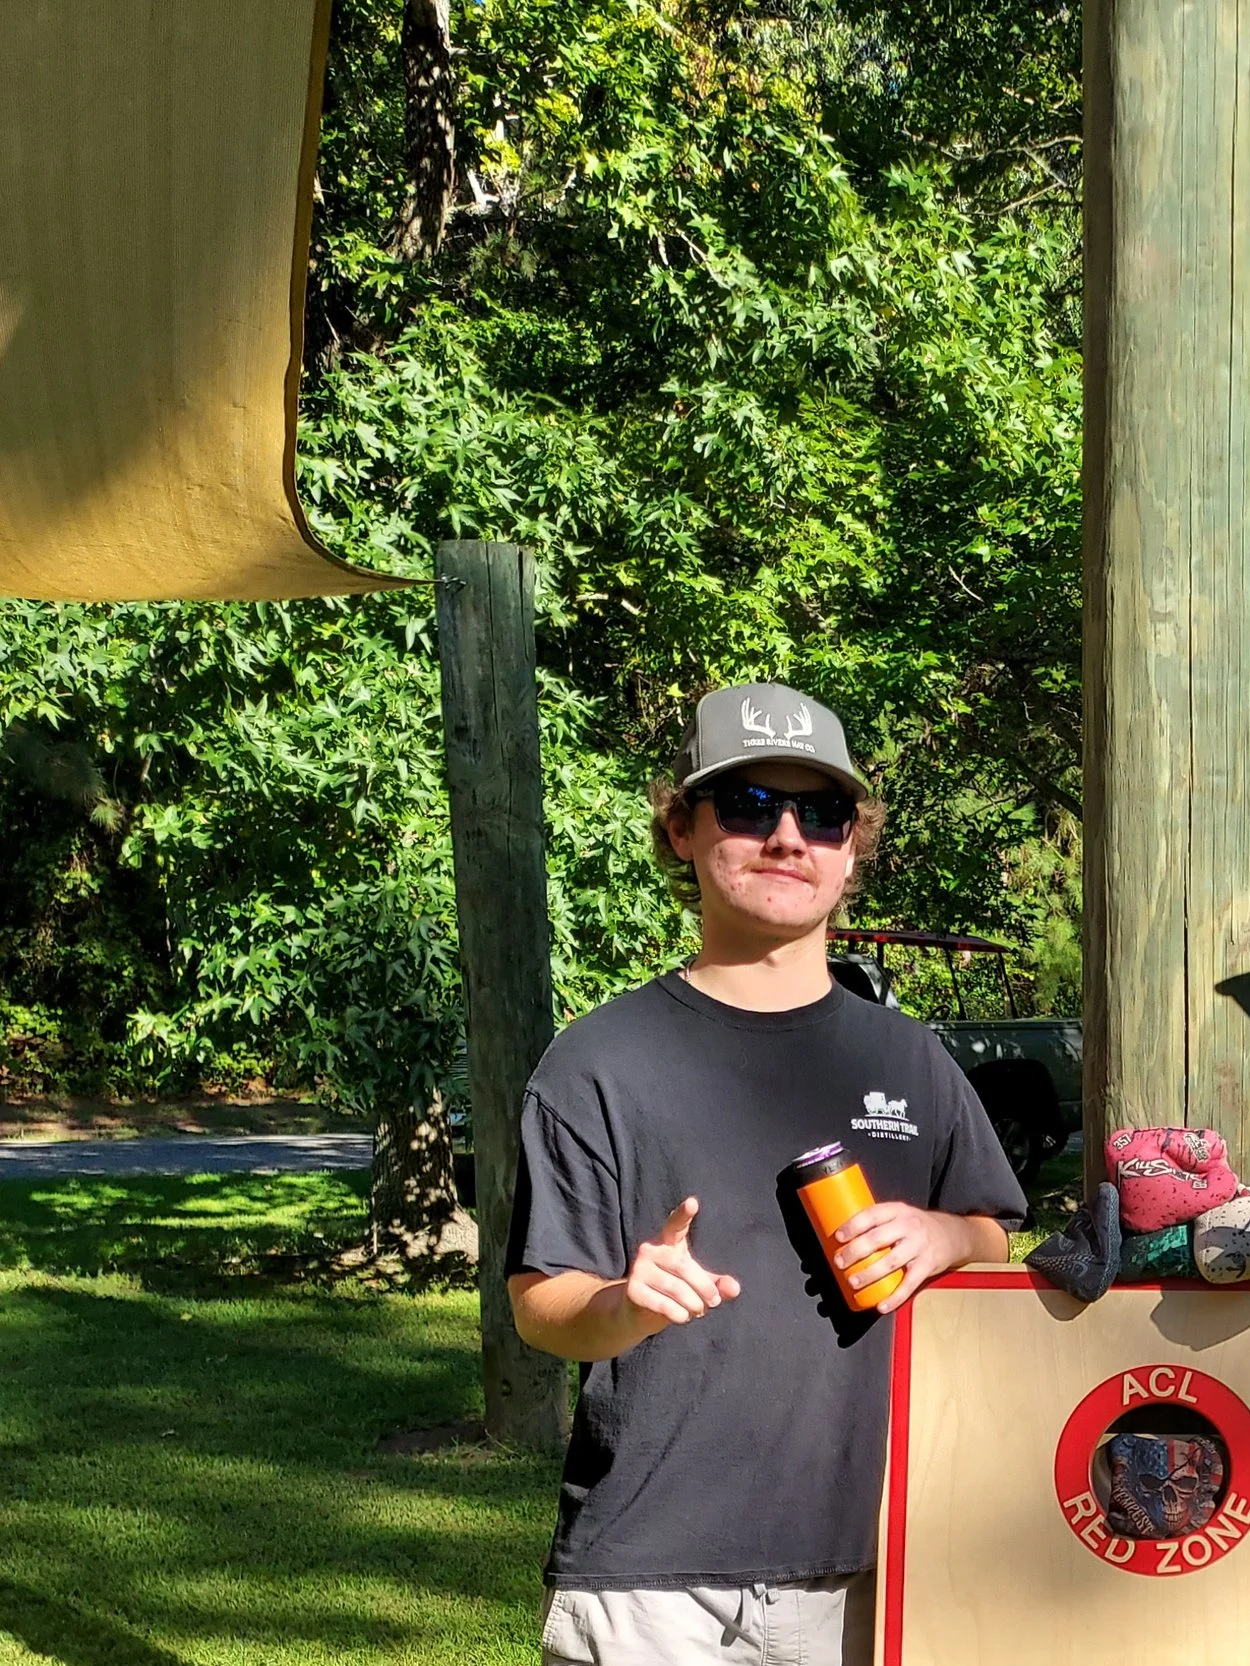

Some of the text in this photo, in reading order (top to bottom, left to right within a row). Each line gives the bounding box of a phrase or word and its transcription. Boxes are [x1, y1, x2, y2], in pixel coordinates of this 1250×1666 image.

[851, 1118, 919, 1137] SOUTHERN TRAIL
[872, 1132, 909, 1141] DISTILLERY
[1113, 1133, 1132, 1150] 357
[1122, 1367, 1198, 1406] ACL
[1112, 1487, 1155, 1536] TEMPEST
[1063, 1491, 1136, 1564] RED
